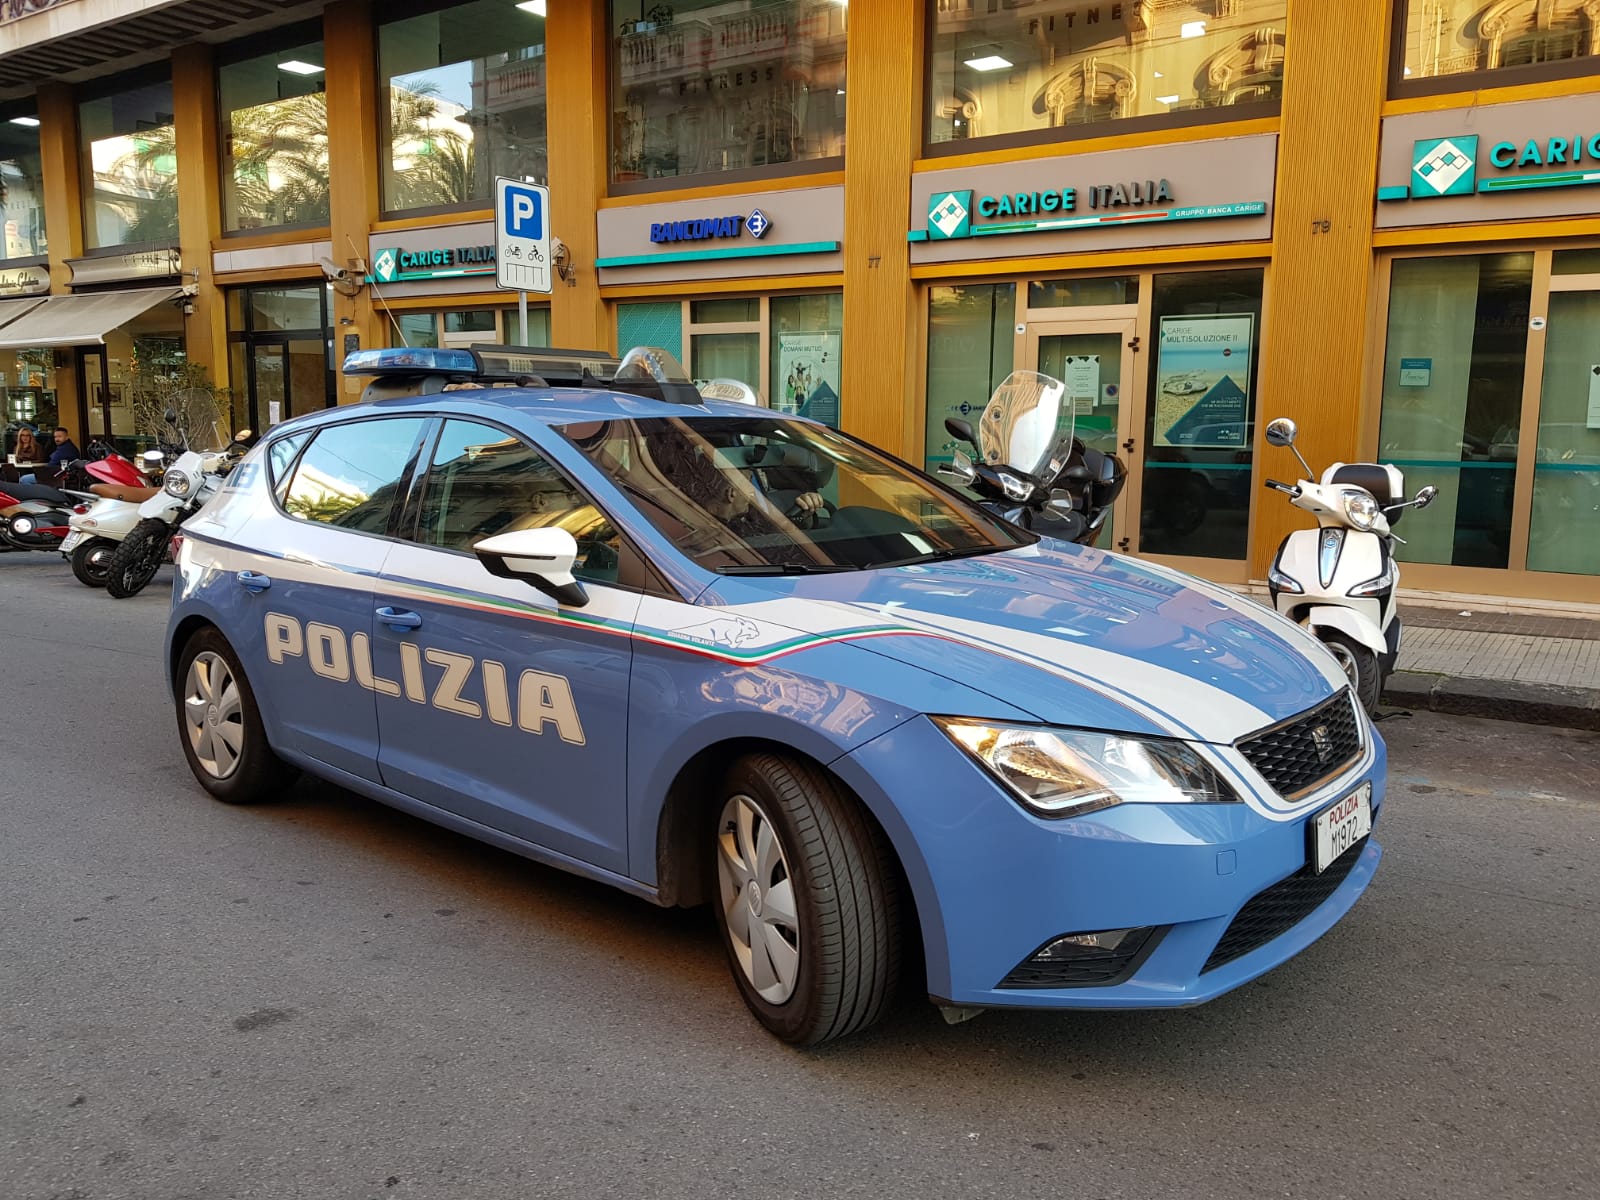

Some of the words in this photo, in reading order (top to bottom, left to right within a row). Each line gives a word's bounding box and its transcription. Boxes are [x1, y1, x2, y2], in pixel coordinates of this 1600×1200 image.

[512, 193, 534, 231] P
[978, 187, 1076, 218] CARIGE
[1089, 178, 1172, 209] ITALIA
[1175, 208, 1205, 217] GRUPPO
[1207, 206, 1232, 215] BANCA
[650, 215, 743, 242] BANCOMAT
[1311, 219, 1331, 235] 79
[400, 248, 450, 268] CARIGE
[456, 245, 496, 264] ITALIA
[1166, 334, 1232, 344] MULTISOLUZIONE
[263, 611, 586, 746] POLIZIA
[1329, 794, 1359, 829] POLIZIA
[1331, 816, 1358, 859] M1972
